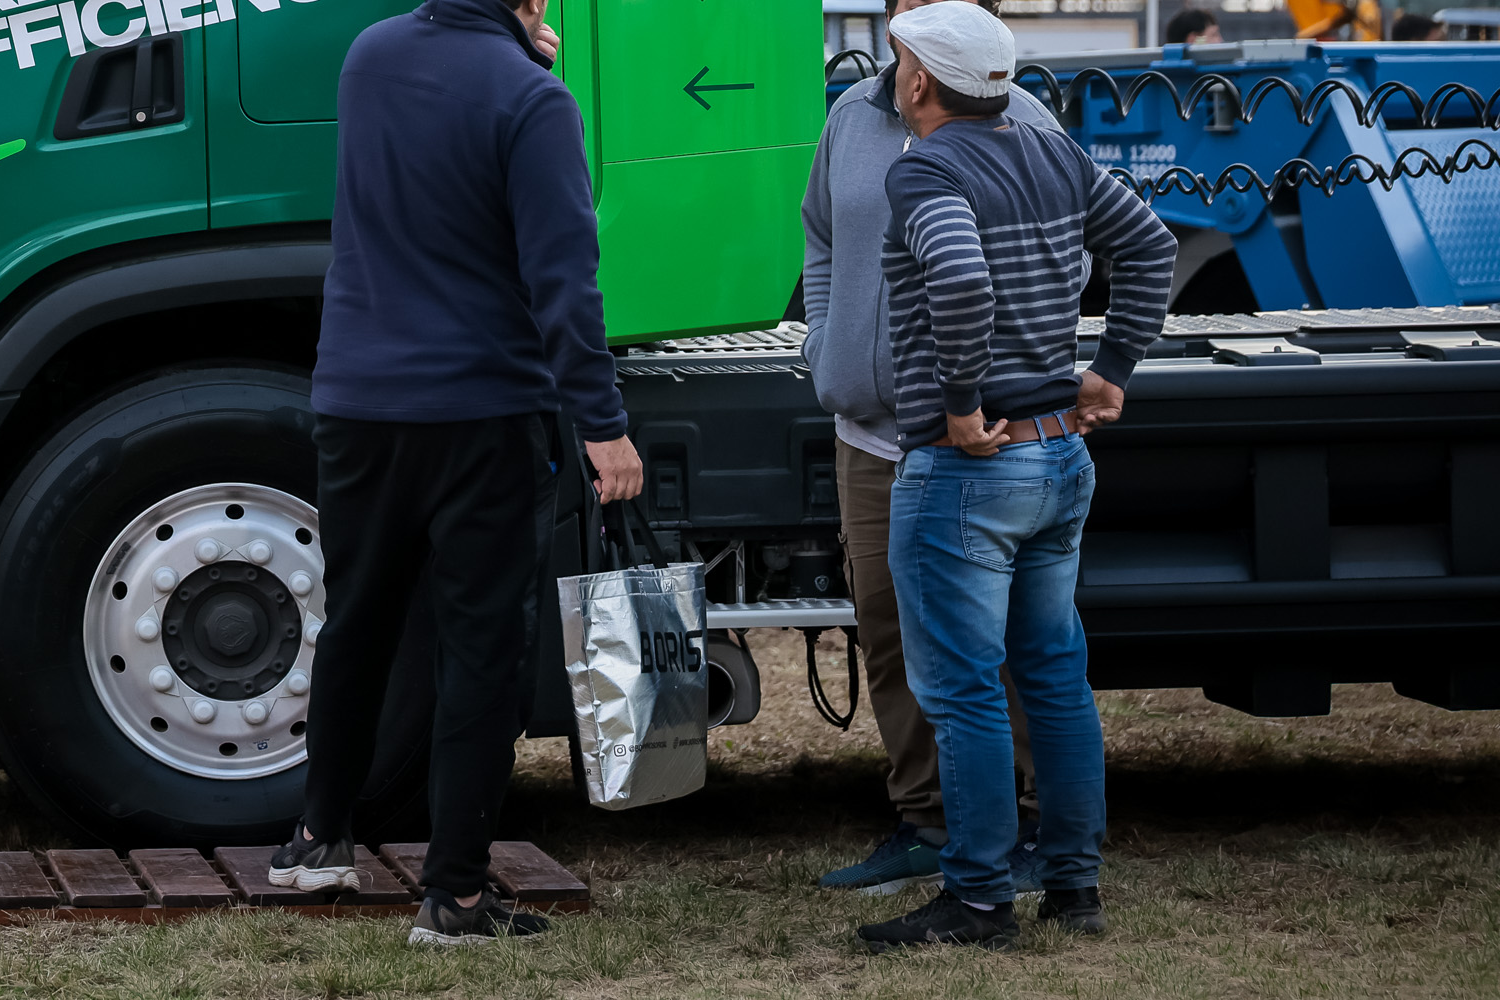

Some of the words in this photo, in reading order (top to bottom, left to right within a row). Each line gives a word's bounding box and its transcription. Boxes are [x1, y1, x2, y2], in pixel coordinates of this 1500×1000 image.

[1088, 144, 1122, 161] TARA
[1129, 144, 1176, 162] 12000
[641, 630, 702, 673] BORIS
